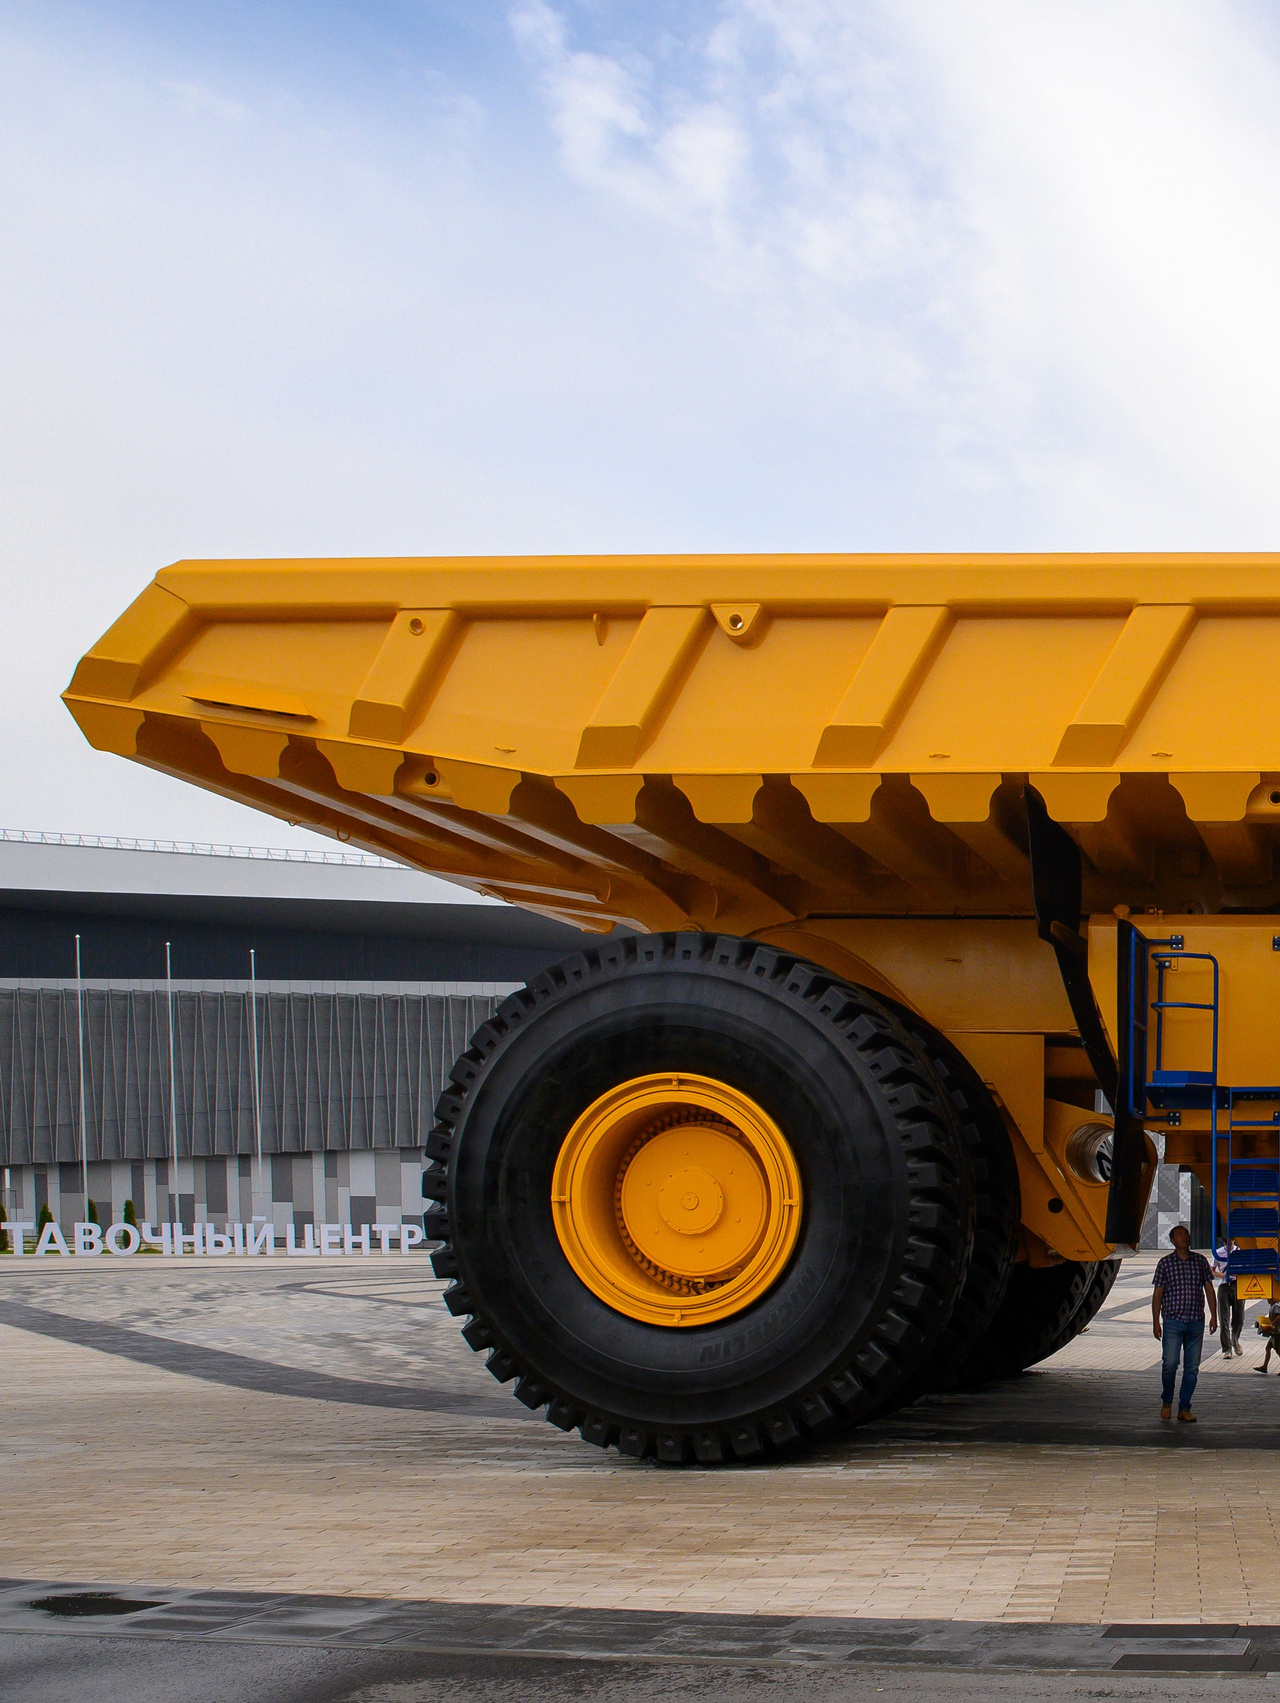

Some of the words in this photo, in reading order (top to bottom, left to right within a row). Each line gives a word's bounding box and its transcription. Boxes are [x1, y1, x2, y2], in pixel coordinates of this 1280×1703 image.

[0, 1216, 275, 1257] ТАВОЧНЫЙ
[286, 1223, 424, 1256] ЦЕНТР
[699, 1265, 820, 1364] MICHELIN
